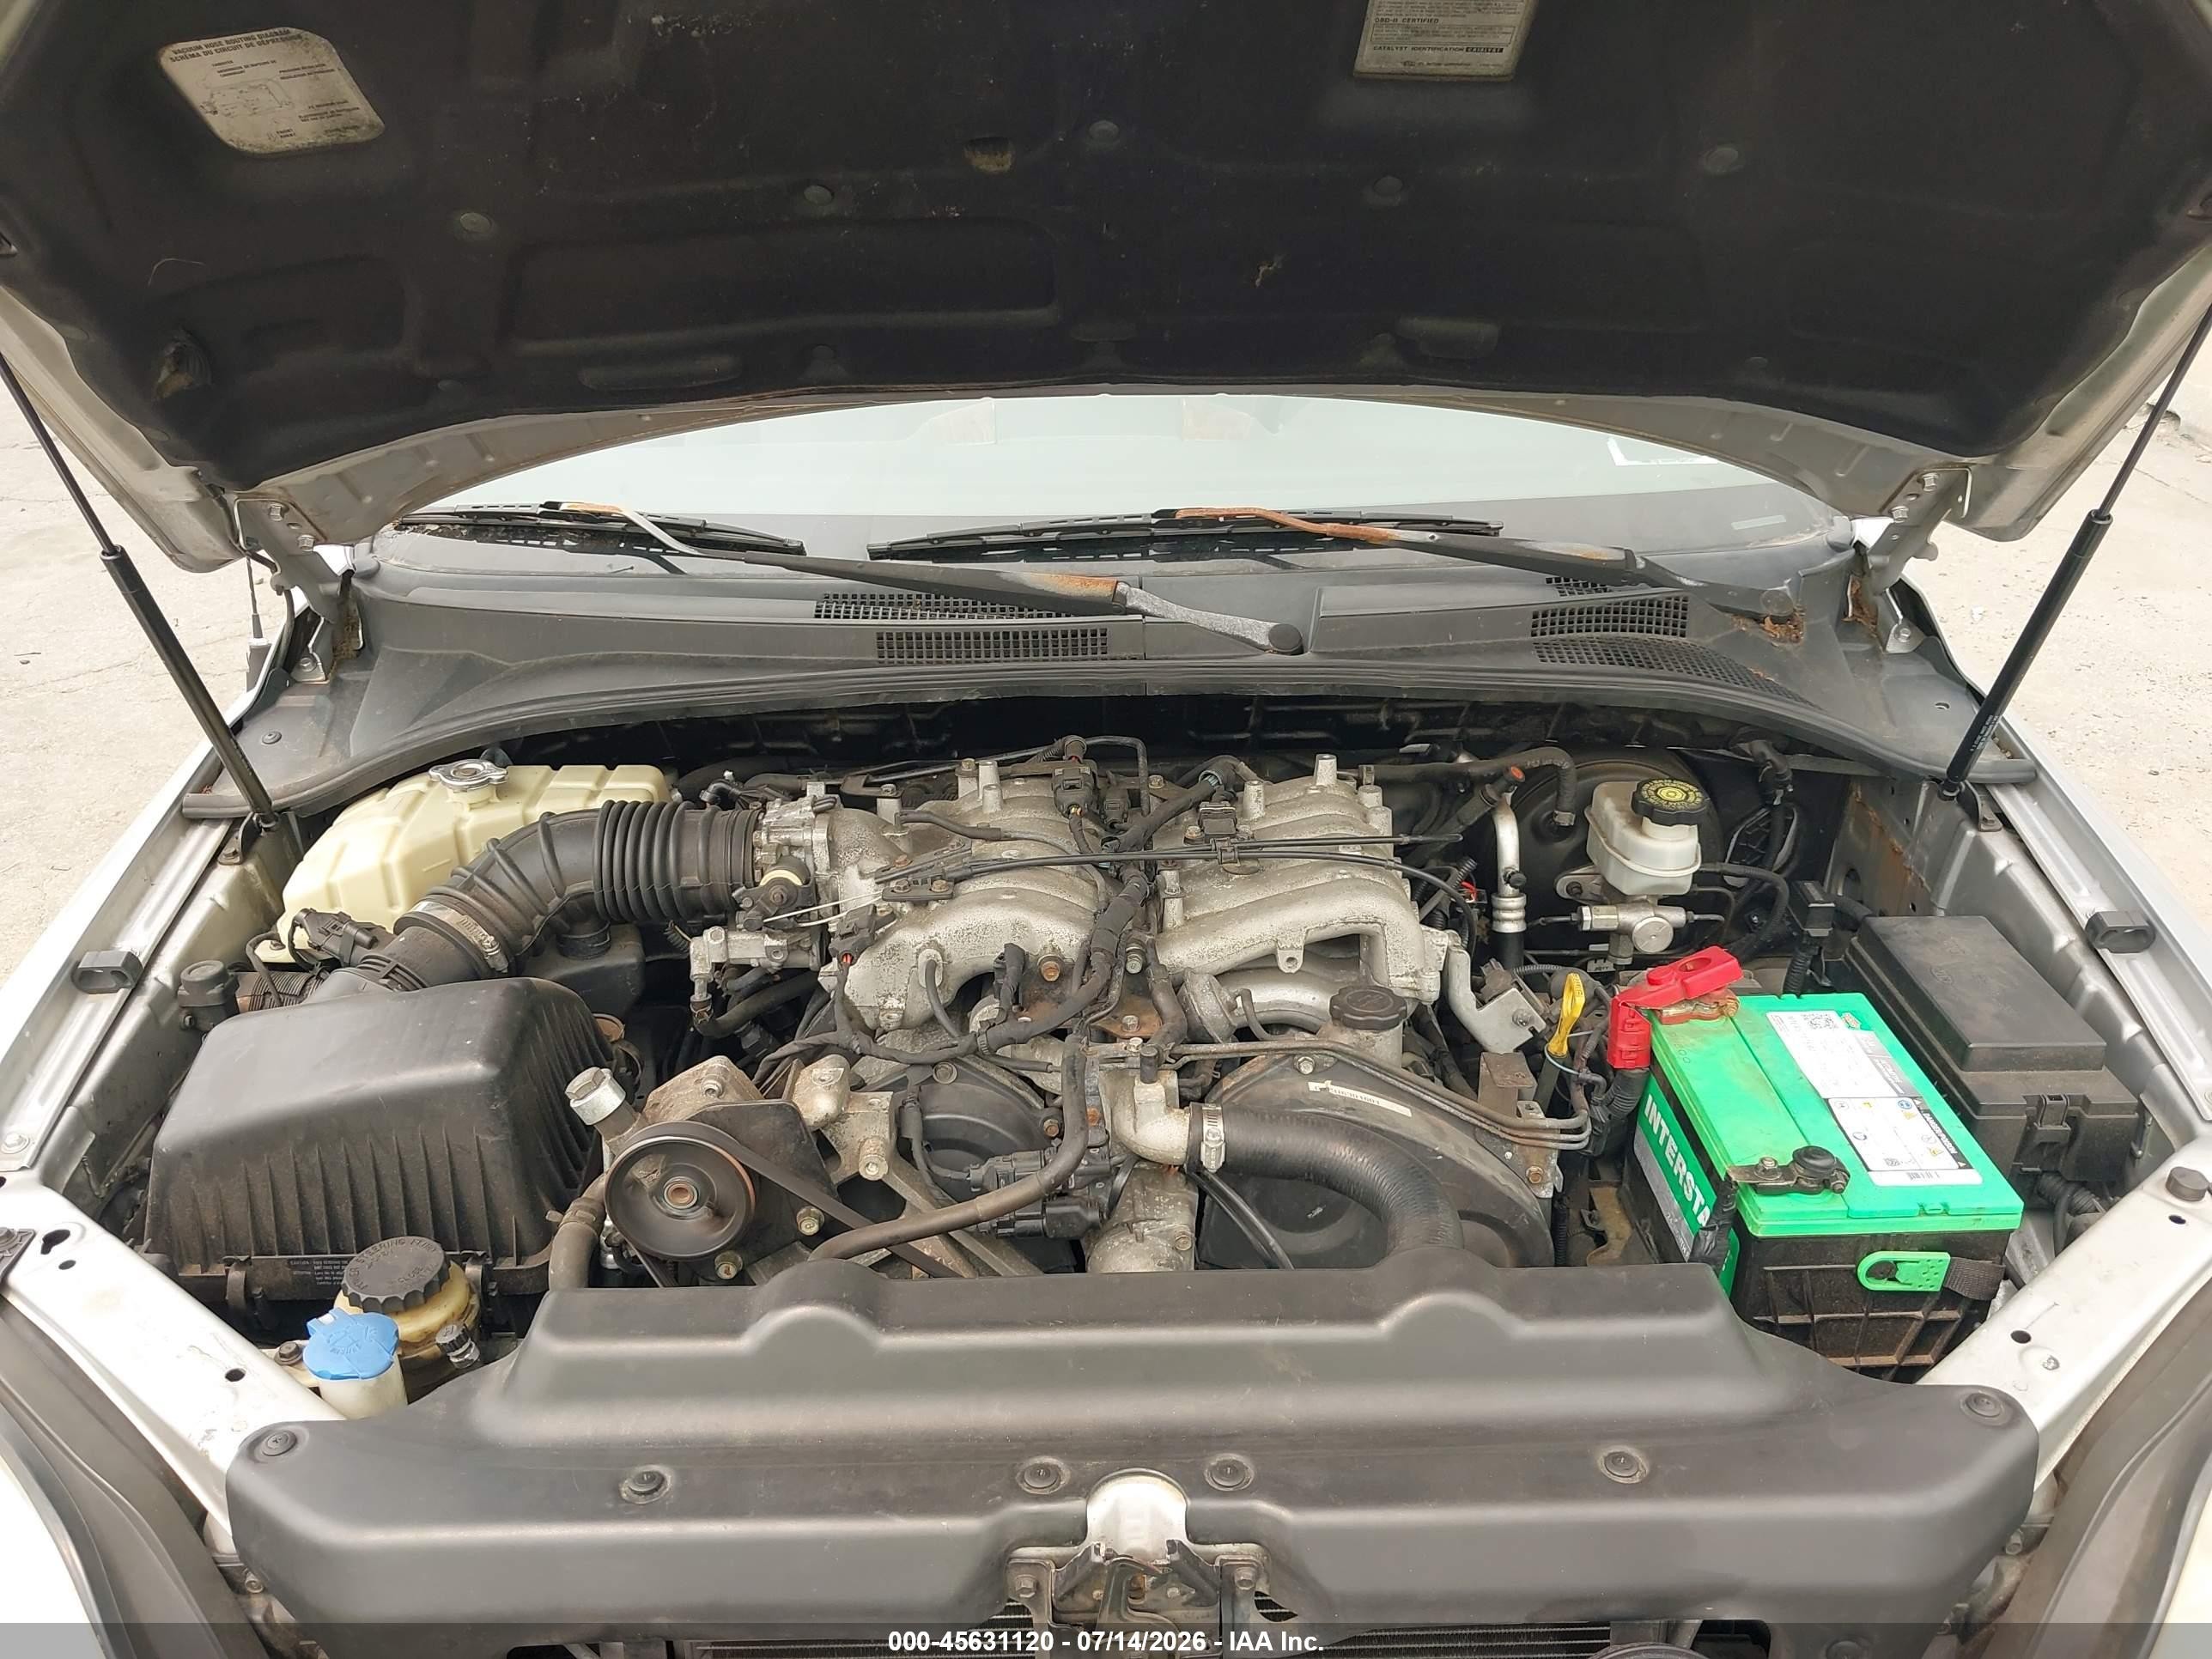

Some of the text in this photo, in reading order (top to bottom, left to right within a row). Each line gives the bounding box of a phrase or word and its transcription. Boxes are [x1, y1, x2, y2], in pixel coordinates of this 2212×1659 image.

[172, 29, 291, 55] VACUUM HOSE ROUTING DIAGRAM
[214, 44, 243, 54] CIRCUIT
